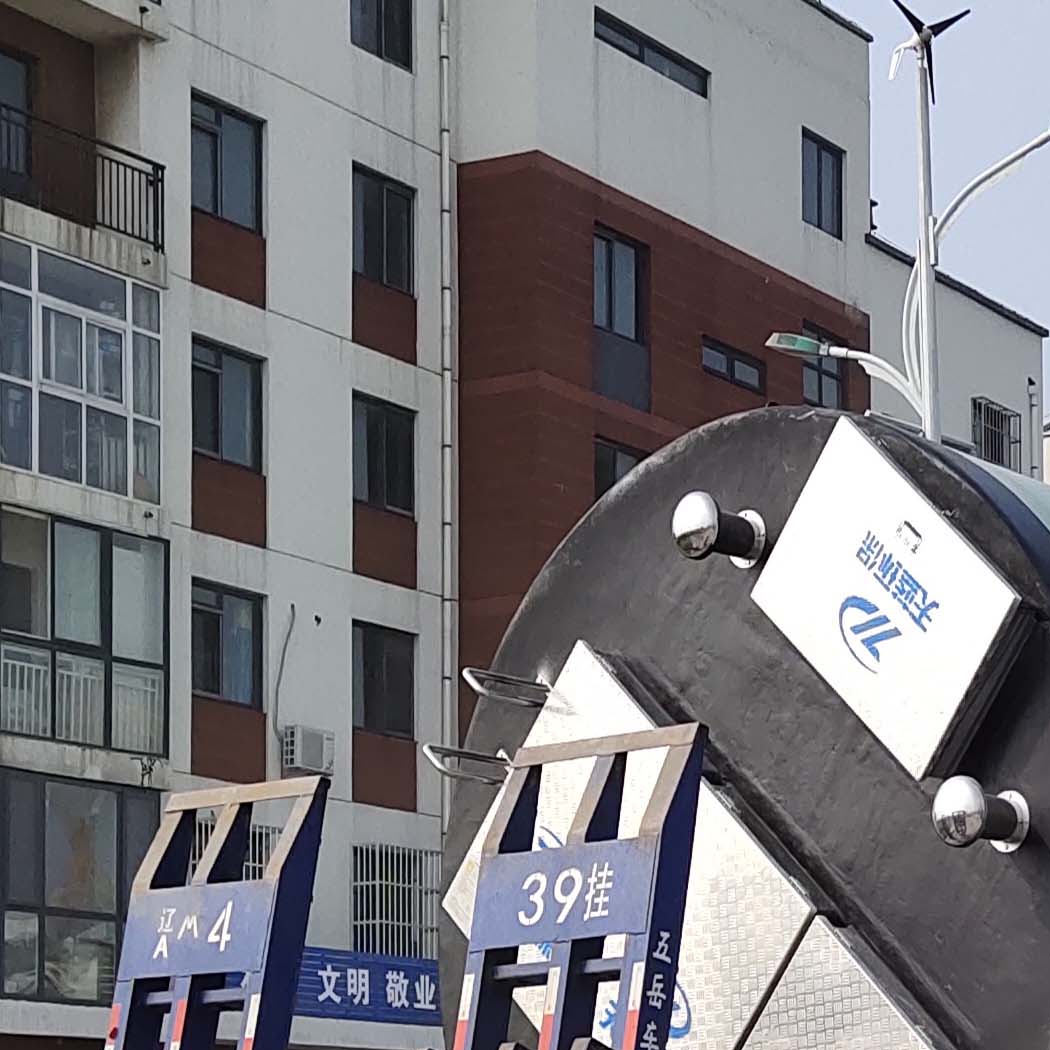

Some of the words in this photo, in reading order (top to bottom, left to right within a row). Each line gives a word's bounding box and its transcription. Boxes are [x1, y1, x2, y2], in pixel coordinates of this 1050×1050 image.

[856, 531, 939, 632] 天蓝环保
[518, 862, 614, 926] 39挂
[318, 964, 369, 1005] 文明
